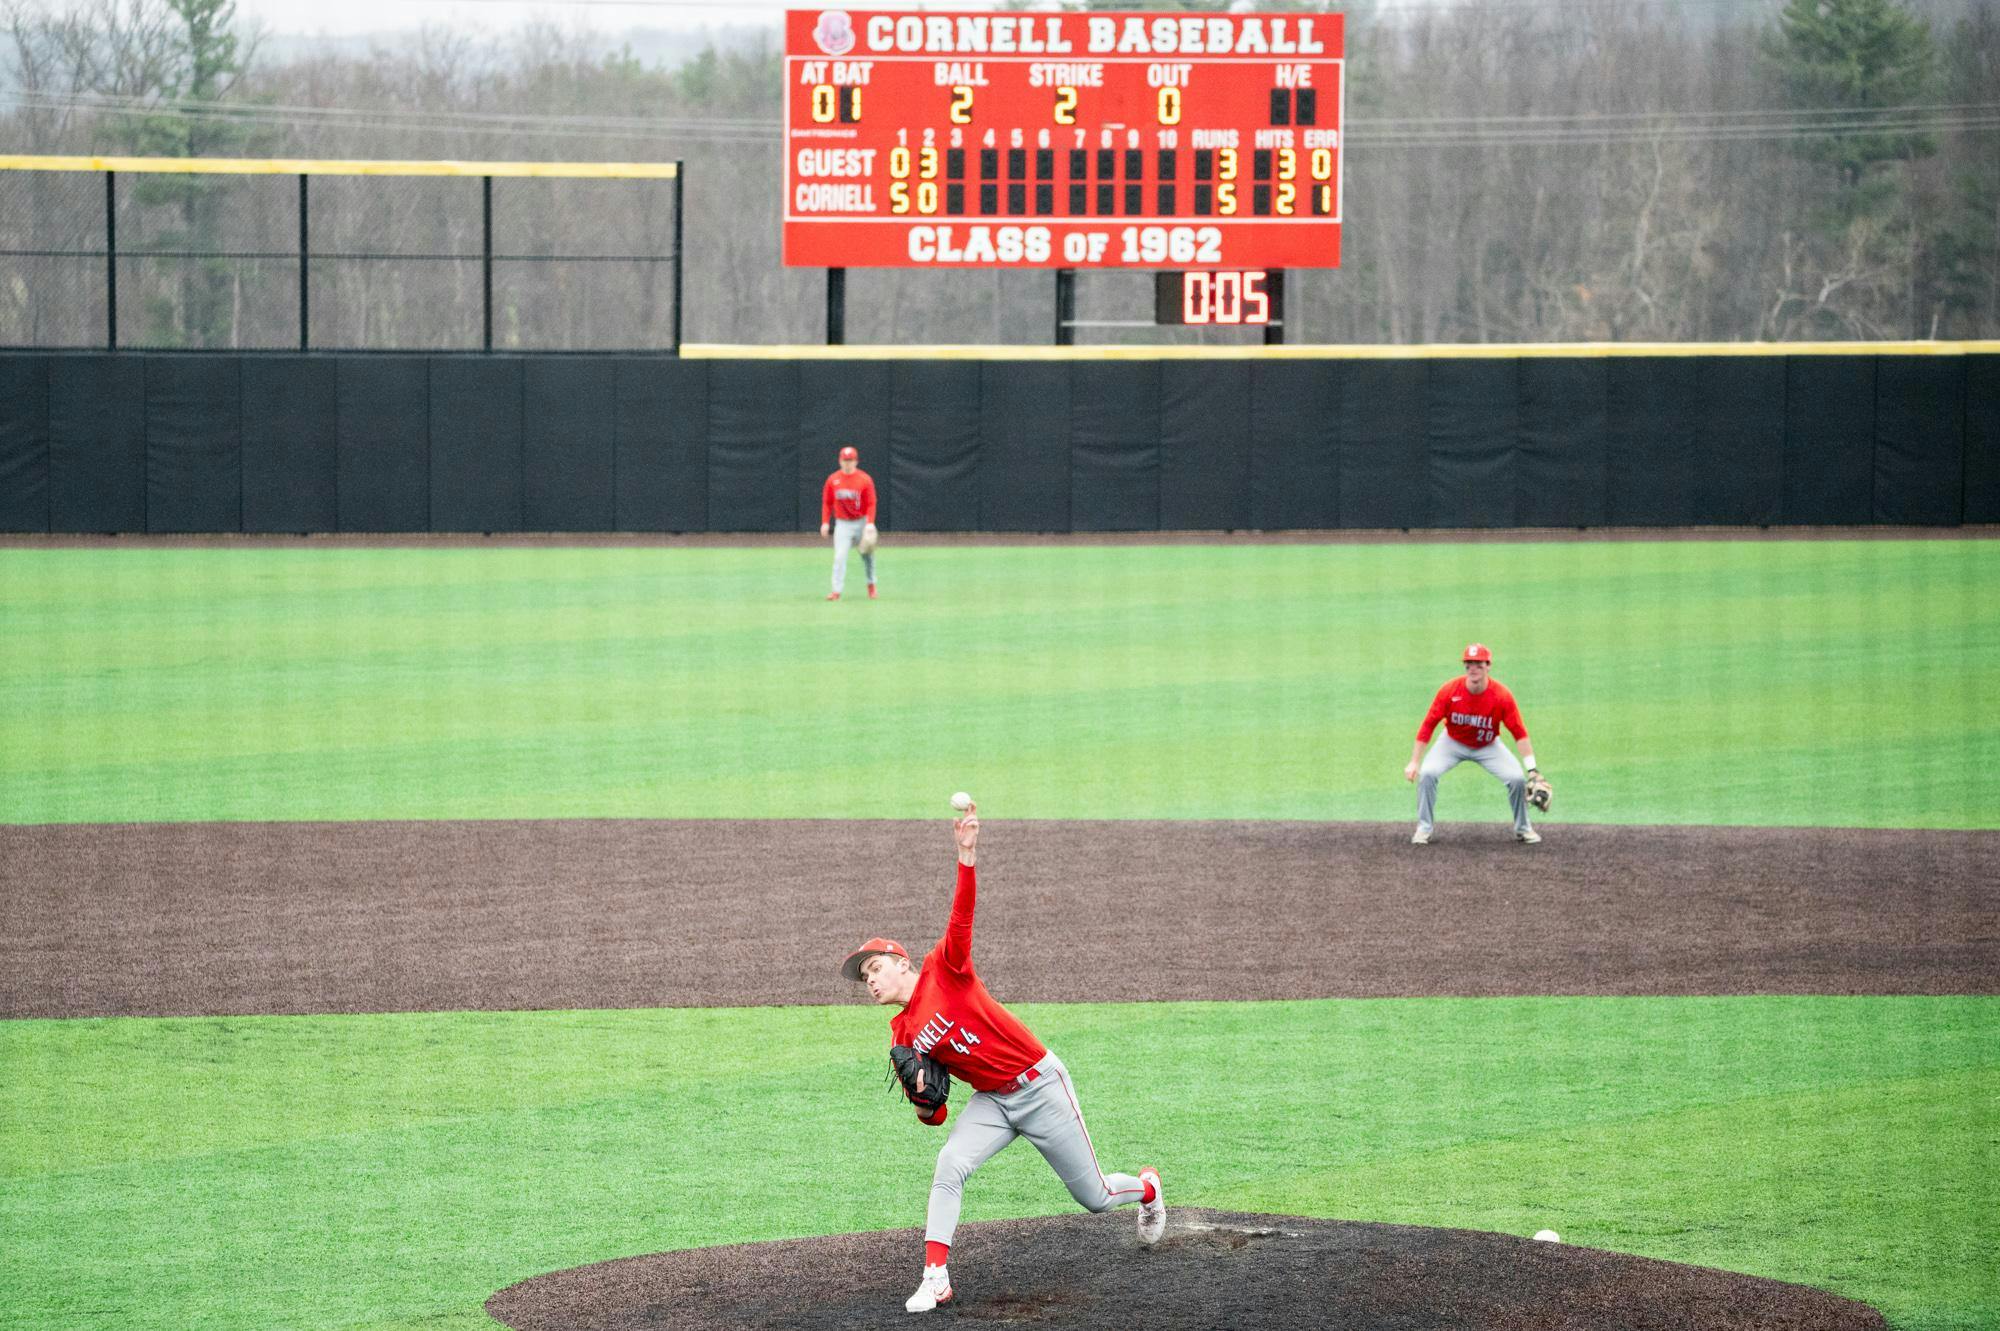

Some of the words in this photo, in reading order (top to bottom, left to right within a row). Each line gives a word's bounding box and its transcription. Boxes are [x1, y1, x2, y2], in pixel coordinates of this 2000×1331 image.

[867, 16, 1072, 53] CORNELL
[1088, 17, 1324, 54] BASEBALL
[800, 61, 828, 85] AT
[832, 61, 874, 85] BAT
[934, 62, 989, 86] BALL
[1028, 63, 1104, 87] STRIKE
[1147, 63, 1193, 87] OUT
[1275, 64, 1312, 89] H/E
[950, 86, 974, 123] 2
[1054, 86, 1077, 124] 2
[1158, 87, 1181, 125] 0
[897, 128, 907, 147] 1
[923, 128, 935, 147] 2
[950, 128, 963, 148] 3
[983, 128, 995, 148] 4
[1011, 128, 1023, 148] 5
[1038, 128, 1050, 148] 6
[1074, 129, 1086, 148] 7
[1101, 129, 1112, 148] 8
[1127, 129, 1139, 148] 9
[1157, 129, 1177, 149] 10
[1192, 129, 1239, 149] RUNS
[1255, 129, 1294, 149] HITS
[1304, 129, 1338, 149] ERR
[797, 149, 877, 177] GUEST
[890, 147, 910, 179] 0
[919, 147, 938, 179] 3
[1219, 148, 1238, 180] 3
[1278, 148, 1296, 180] 3
[1312, 148, 1331, 180] 0
[795, 184, 877, 212] CORNELL
[890, 182, 910, 213] 5
[917, 182, 938, 213] 0
[1217, 183, 1237, 215] 5
[1276, 183, 1296, 214] 2
[1321, 185, 1331, 213] 1
[908, 226, 1051, 262] CLASS
[1064, 232, 1109, 262] OF
[1121, 227, 1222, 262] 1962
[1184, 271, 1269, 324] 0:05
[1451, 711, 1493, 729] CORNELL
[1477, 729, 1494, 742] 20
[912, 1012, 954, 1055] RNELL
[949, 1027, 981, 1055] 44
